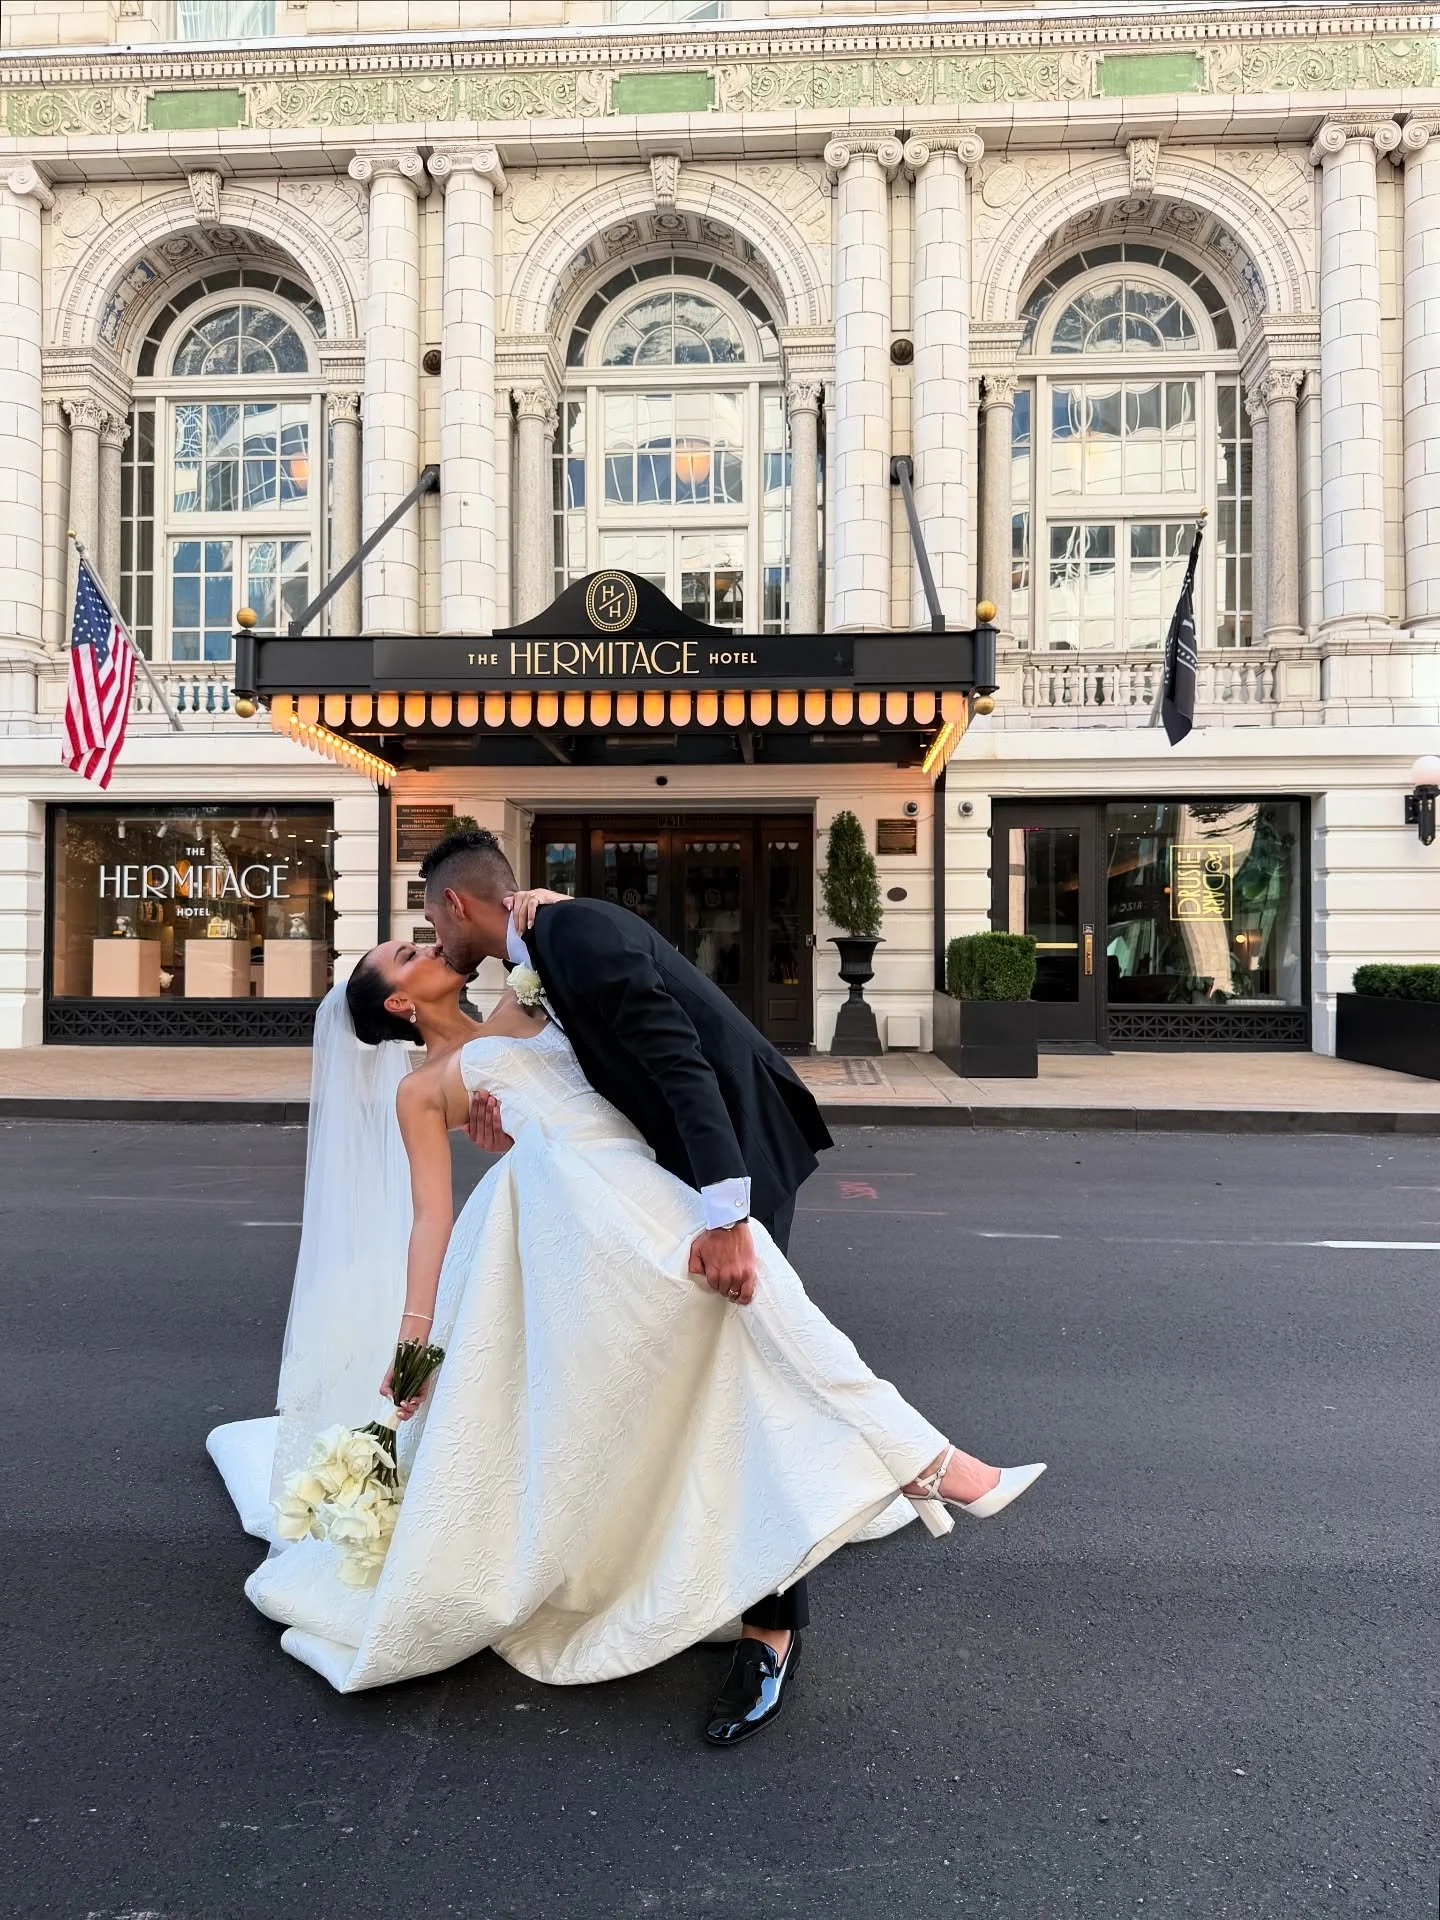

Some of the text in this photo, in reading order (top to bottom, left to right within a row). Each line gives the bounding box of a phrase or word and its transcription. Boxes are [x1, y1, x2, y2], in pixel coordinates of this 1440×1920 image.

[468, 641, 758, 675] THE HERMITAGE HOTEL
[185, 847, 205, 856] THE
[99, 864, 291, 899] HERMITAGE
[1177, 851, 1201, 915] DRUSIE
[1202, 873, 1225, 915] DARR
[176, 907, 210, 917] HOTEL
